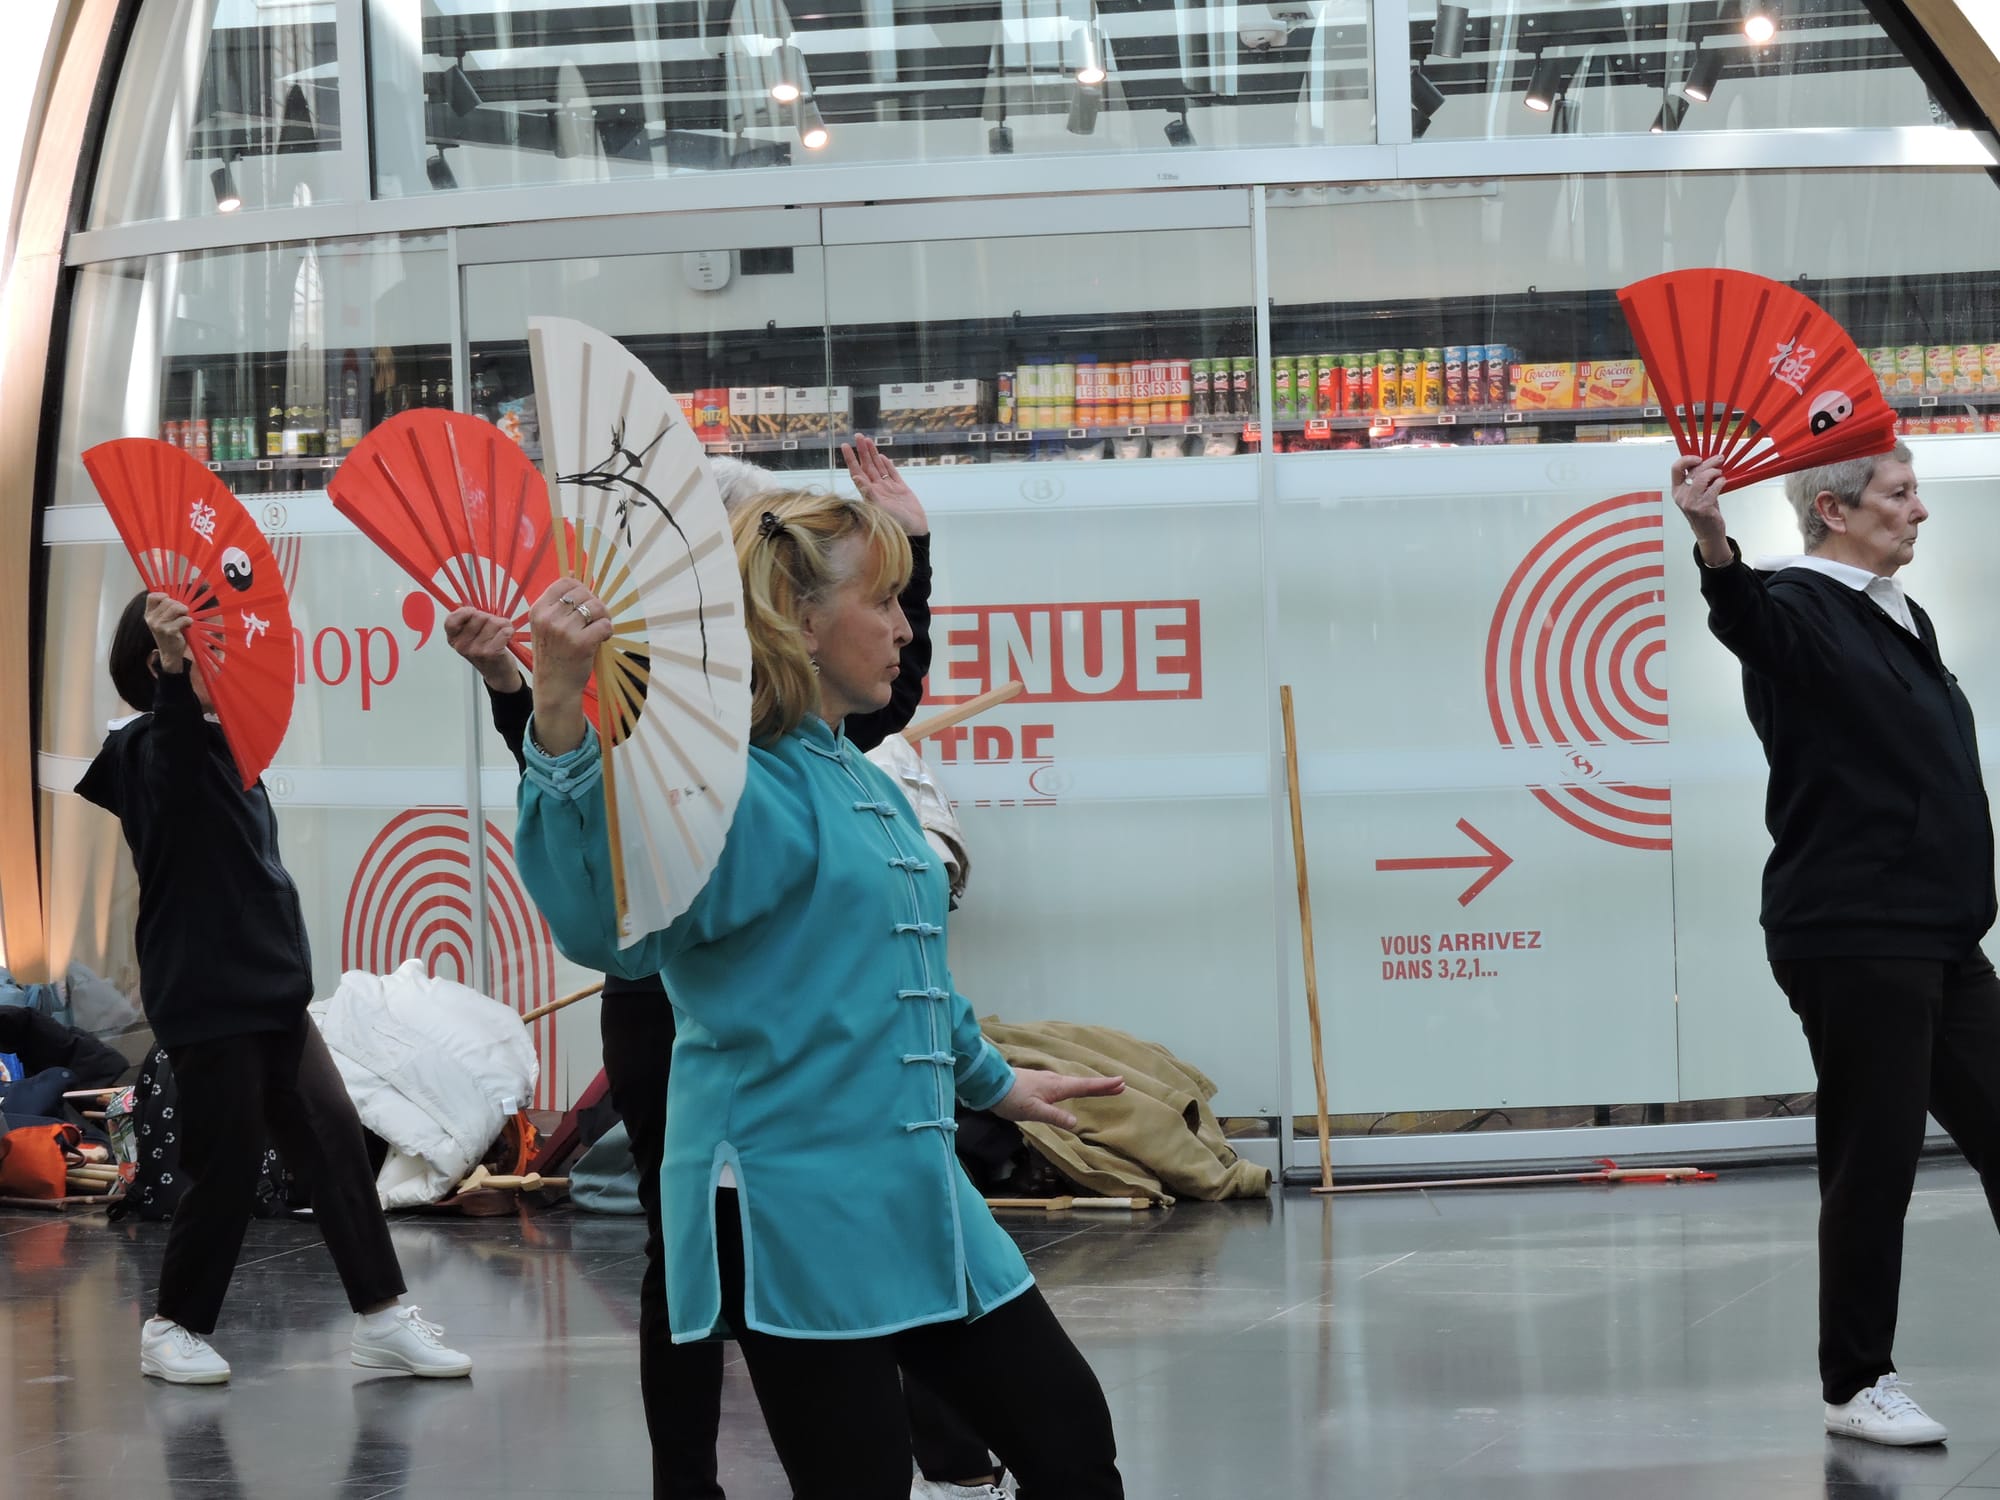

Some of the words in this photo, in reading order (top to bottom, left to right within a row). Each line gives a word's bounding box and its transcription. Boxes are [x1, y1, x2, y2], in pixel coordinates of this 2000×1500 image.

[1381, 935, 1431, 956] VOUS
[1438, 930, 1542, 952] ARRIVEZ
[1382, 959, 1432, 980] DANS
[1438, 958, 1498, 980] 3,2,1...
